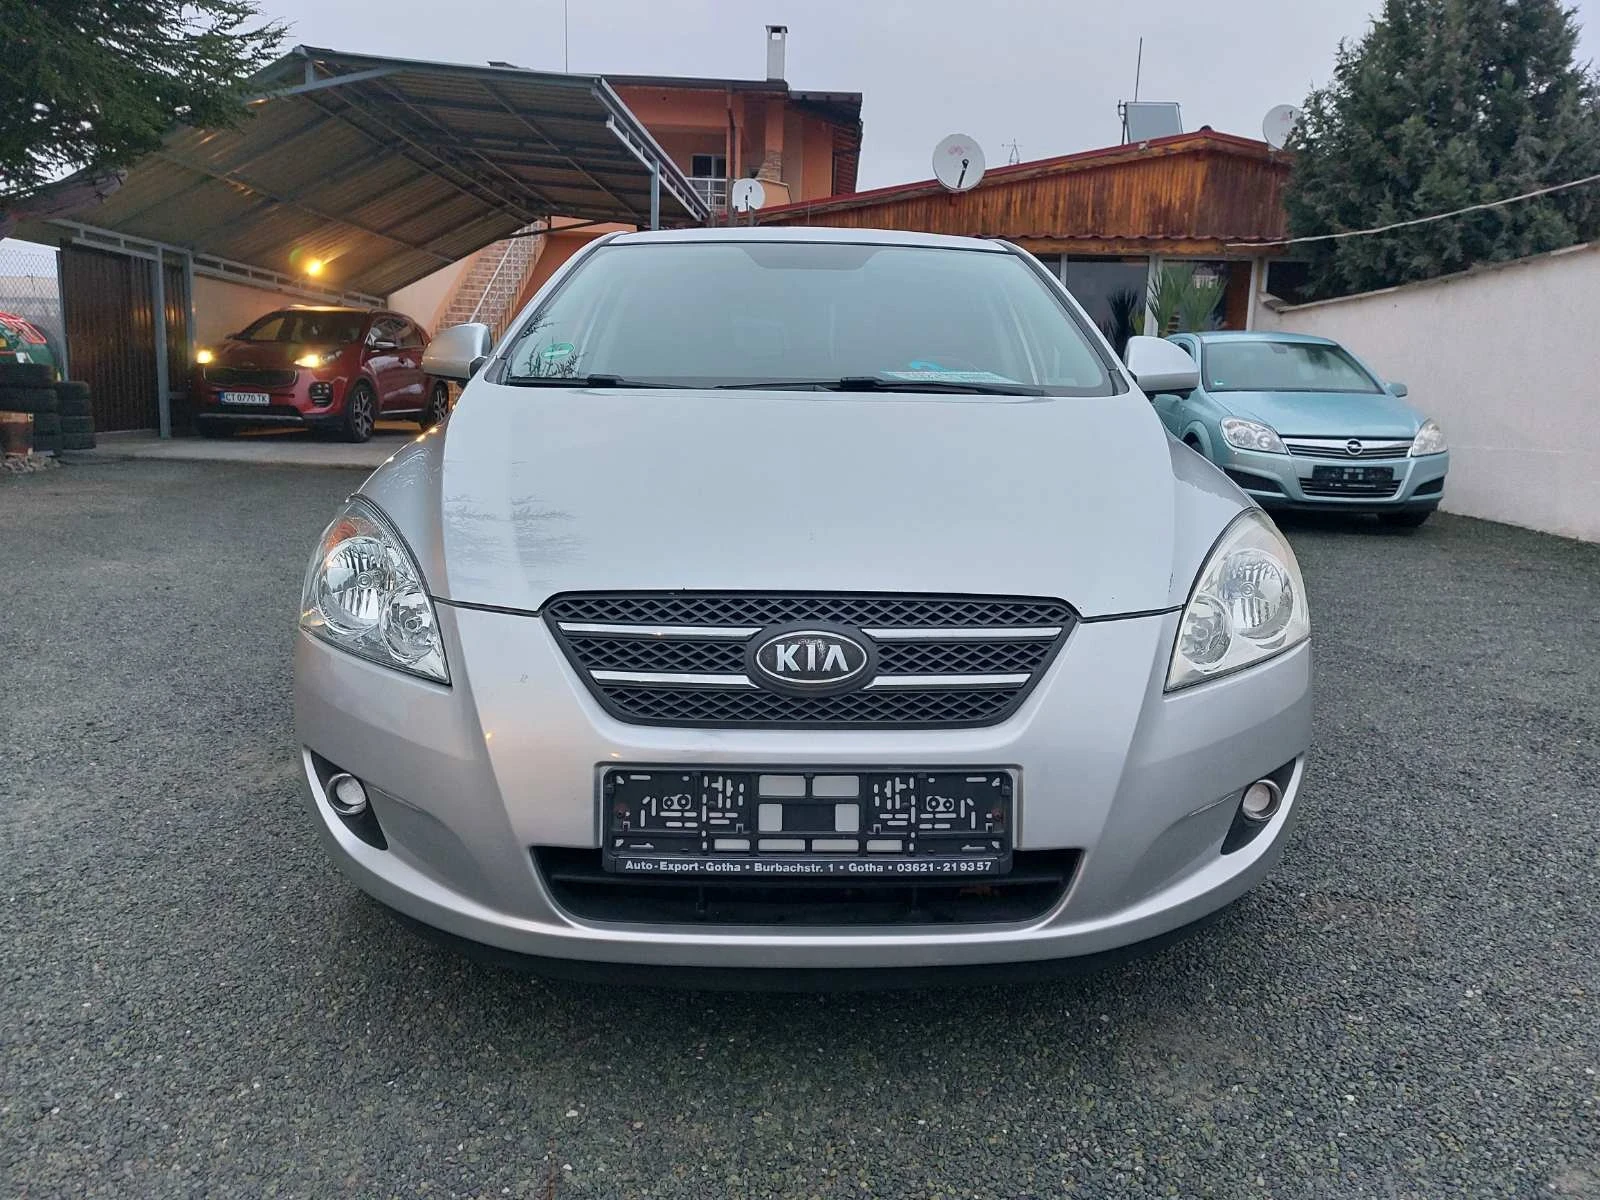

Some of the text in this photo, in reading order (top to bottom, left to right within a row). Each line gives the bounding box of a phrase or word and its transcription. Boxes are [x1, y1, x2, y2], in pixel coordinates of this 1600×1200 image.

[775, 644, 849, 672] KIA
[754, 862, 824, 873] Burbachstr.
[827, 863, 835, 873] 1
[848, 862, 884, 873] Gotha
